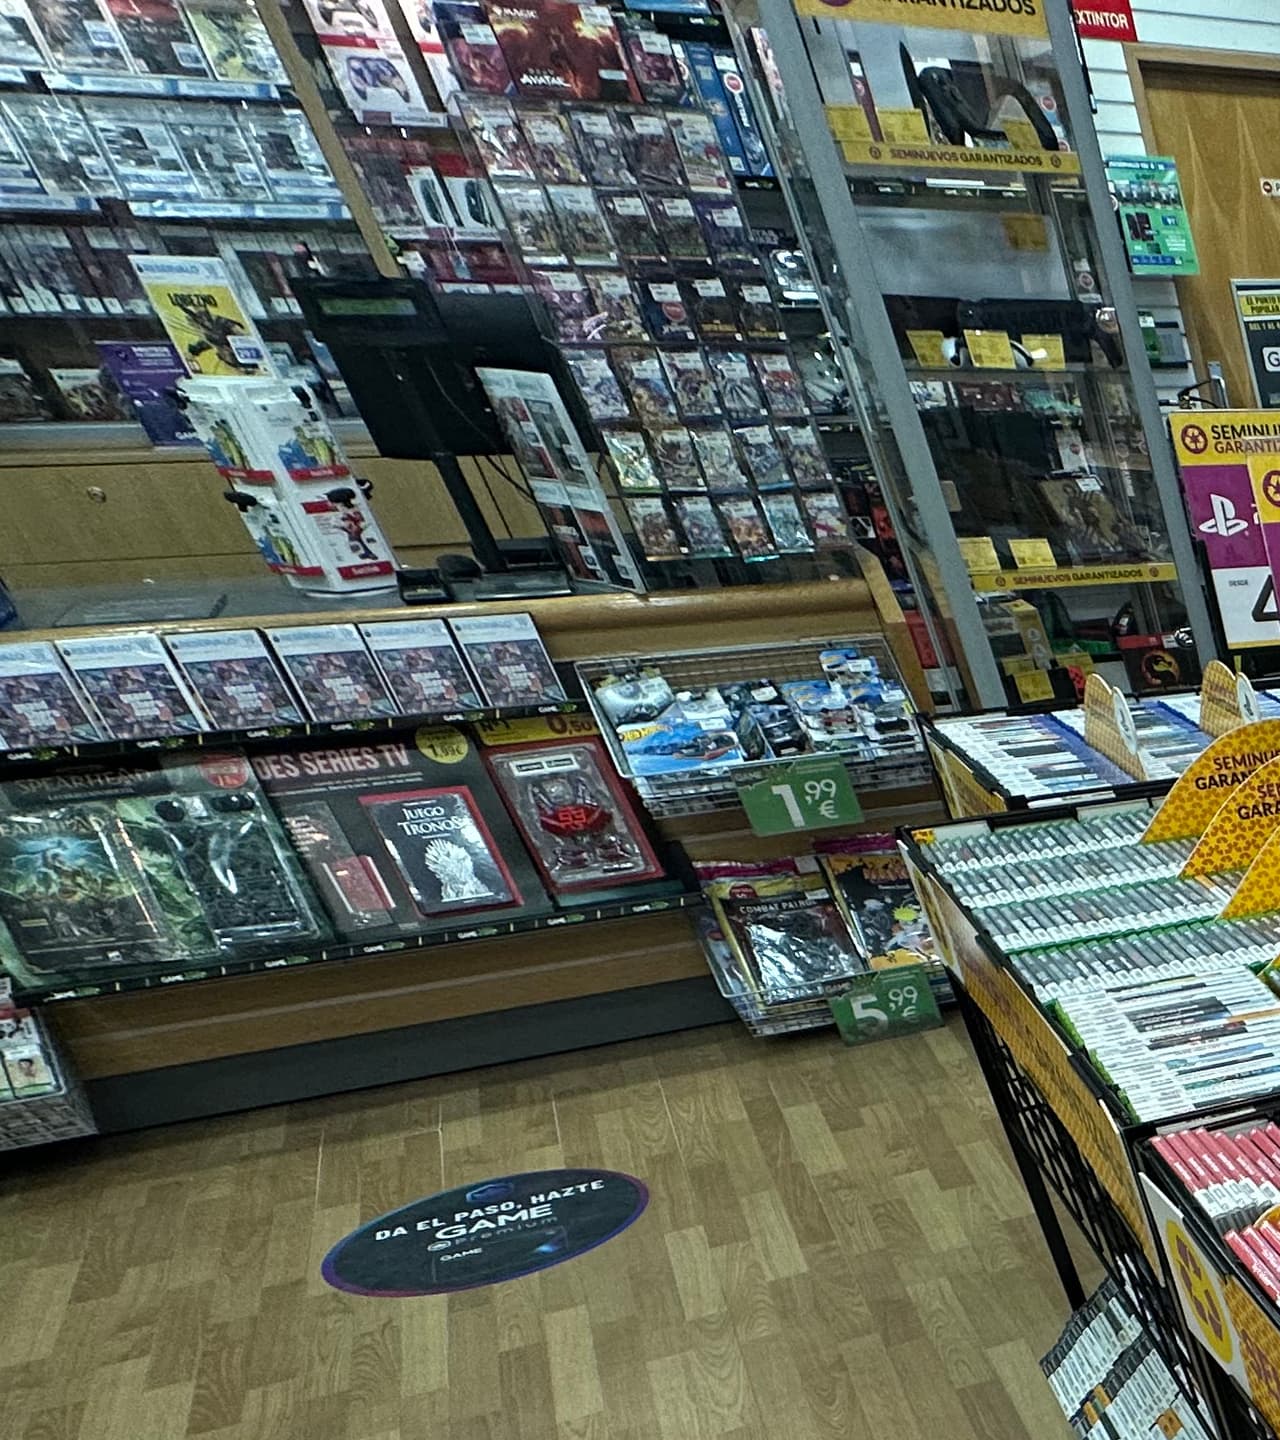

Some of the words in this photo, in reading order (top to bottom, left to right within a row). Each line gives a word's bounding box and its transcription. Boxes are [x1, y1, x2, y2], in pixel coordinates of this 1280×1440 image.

[1073, 9, 1129, 29] XTINTOR
[304, 747, 377, 775] SERIES
[382, 743, 410, 767] TV
[375, 1226, 409, 1242] DA
[416, 1216, 447, 1232] EL
[531, 1178, 605, 1206] HAZTE
[435, 1203, 553, 1240] GAME
[440, 1247, 483, 1262] GAME
